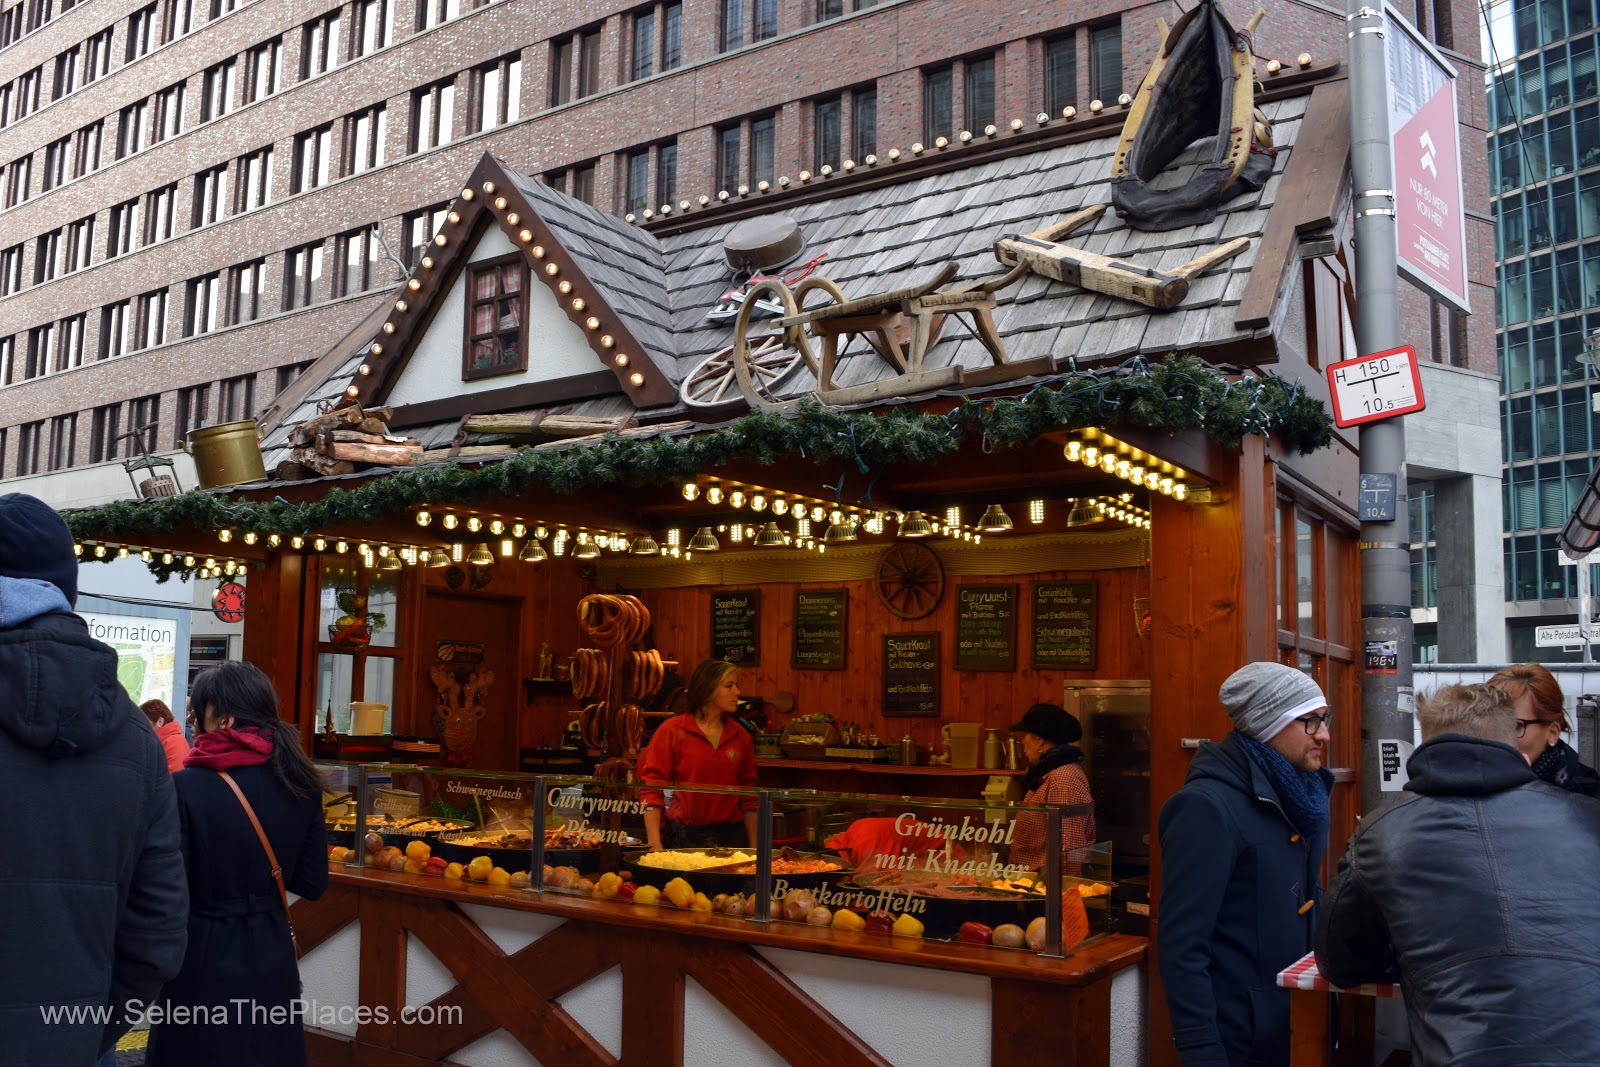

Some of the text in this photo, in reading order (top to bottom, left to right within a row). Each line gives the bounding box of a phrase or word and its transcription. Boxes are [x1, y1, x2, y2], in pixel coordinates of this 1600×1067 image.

[1409, 176, 1449, 218] NUR 80 METER
[1415, 197, 1431, 220] VON
[1335, 369, 1346, 384] H
[1359, 358, 1390, 377] 150
[1361, 479, 1367, 489] S
[87, 618, 171, 643] formation
[1540, 631, 1553, 640] Alte
[1554, 630, 1579, 640] Potsdam
[445, 780, 522, 801] Schweinegulasch
[547, 787, 654, 817] Currywurst-
[564, 819, 628, 848] Pfanne
[894, 812, 1017, 846] Grünkohl
[874, 846, 1032, 881] mit Knacker
